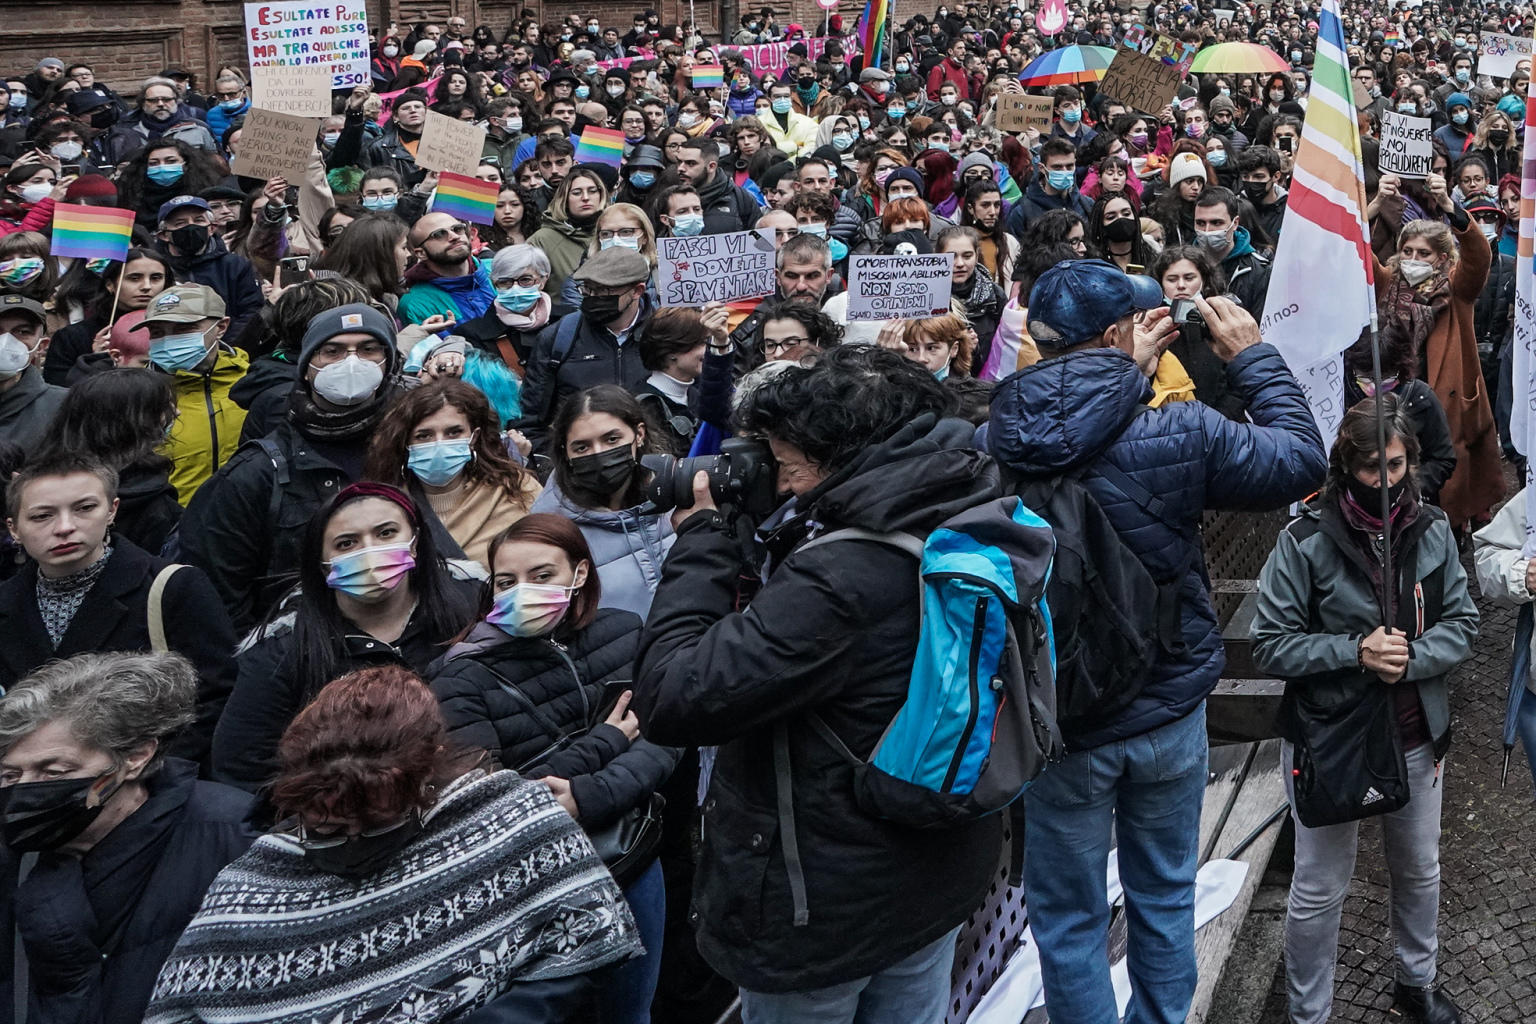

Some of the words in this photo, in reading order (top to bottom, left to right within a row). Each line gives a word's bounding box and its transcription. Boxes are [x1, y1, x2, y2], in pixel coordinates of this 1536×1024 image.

[258, 6, 330, 26] ESULTATE
[336, 5, 366, 21] PURE
[251, 26, 313, 41] ESULTATE
[253, 44, 277, 58] MA
[283, 42, 309, 56] TRA
[312, 39, 360, 52] QUALCHE
[289, 78, 304, 87] CHI
[249, 109, 272, 127] YOU
[275, 119, 305, 132] KNOW
[1013, 115, 1023, 124] UN
[1398, 116, 1408, 127] VI
[240, 138, 281, 154] SERIOUS
[253, 128, 288, 144] THINGS
[293, 137, 311, 148] ARE
[1387, 138, 1407, 154] NOI
[664, 236, 717, 260] FASCI
[725, 234, 746, 255] VI
[693, 253, 766, 278] DOVETE
[667, 268, 775, 304] SPAVENTARE
[861, 281, 891, 296] NON
[895, 282, 928, 296] SONO
